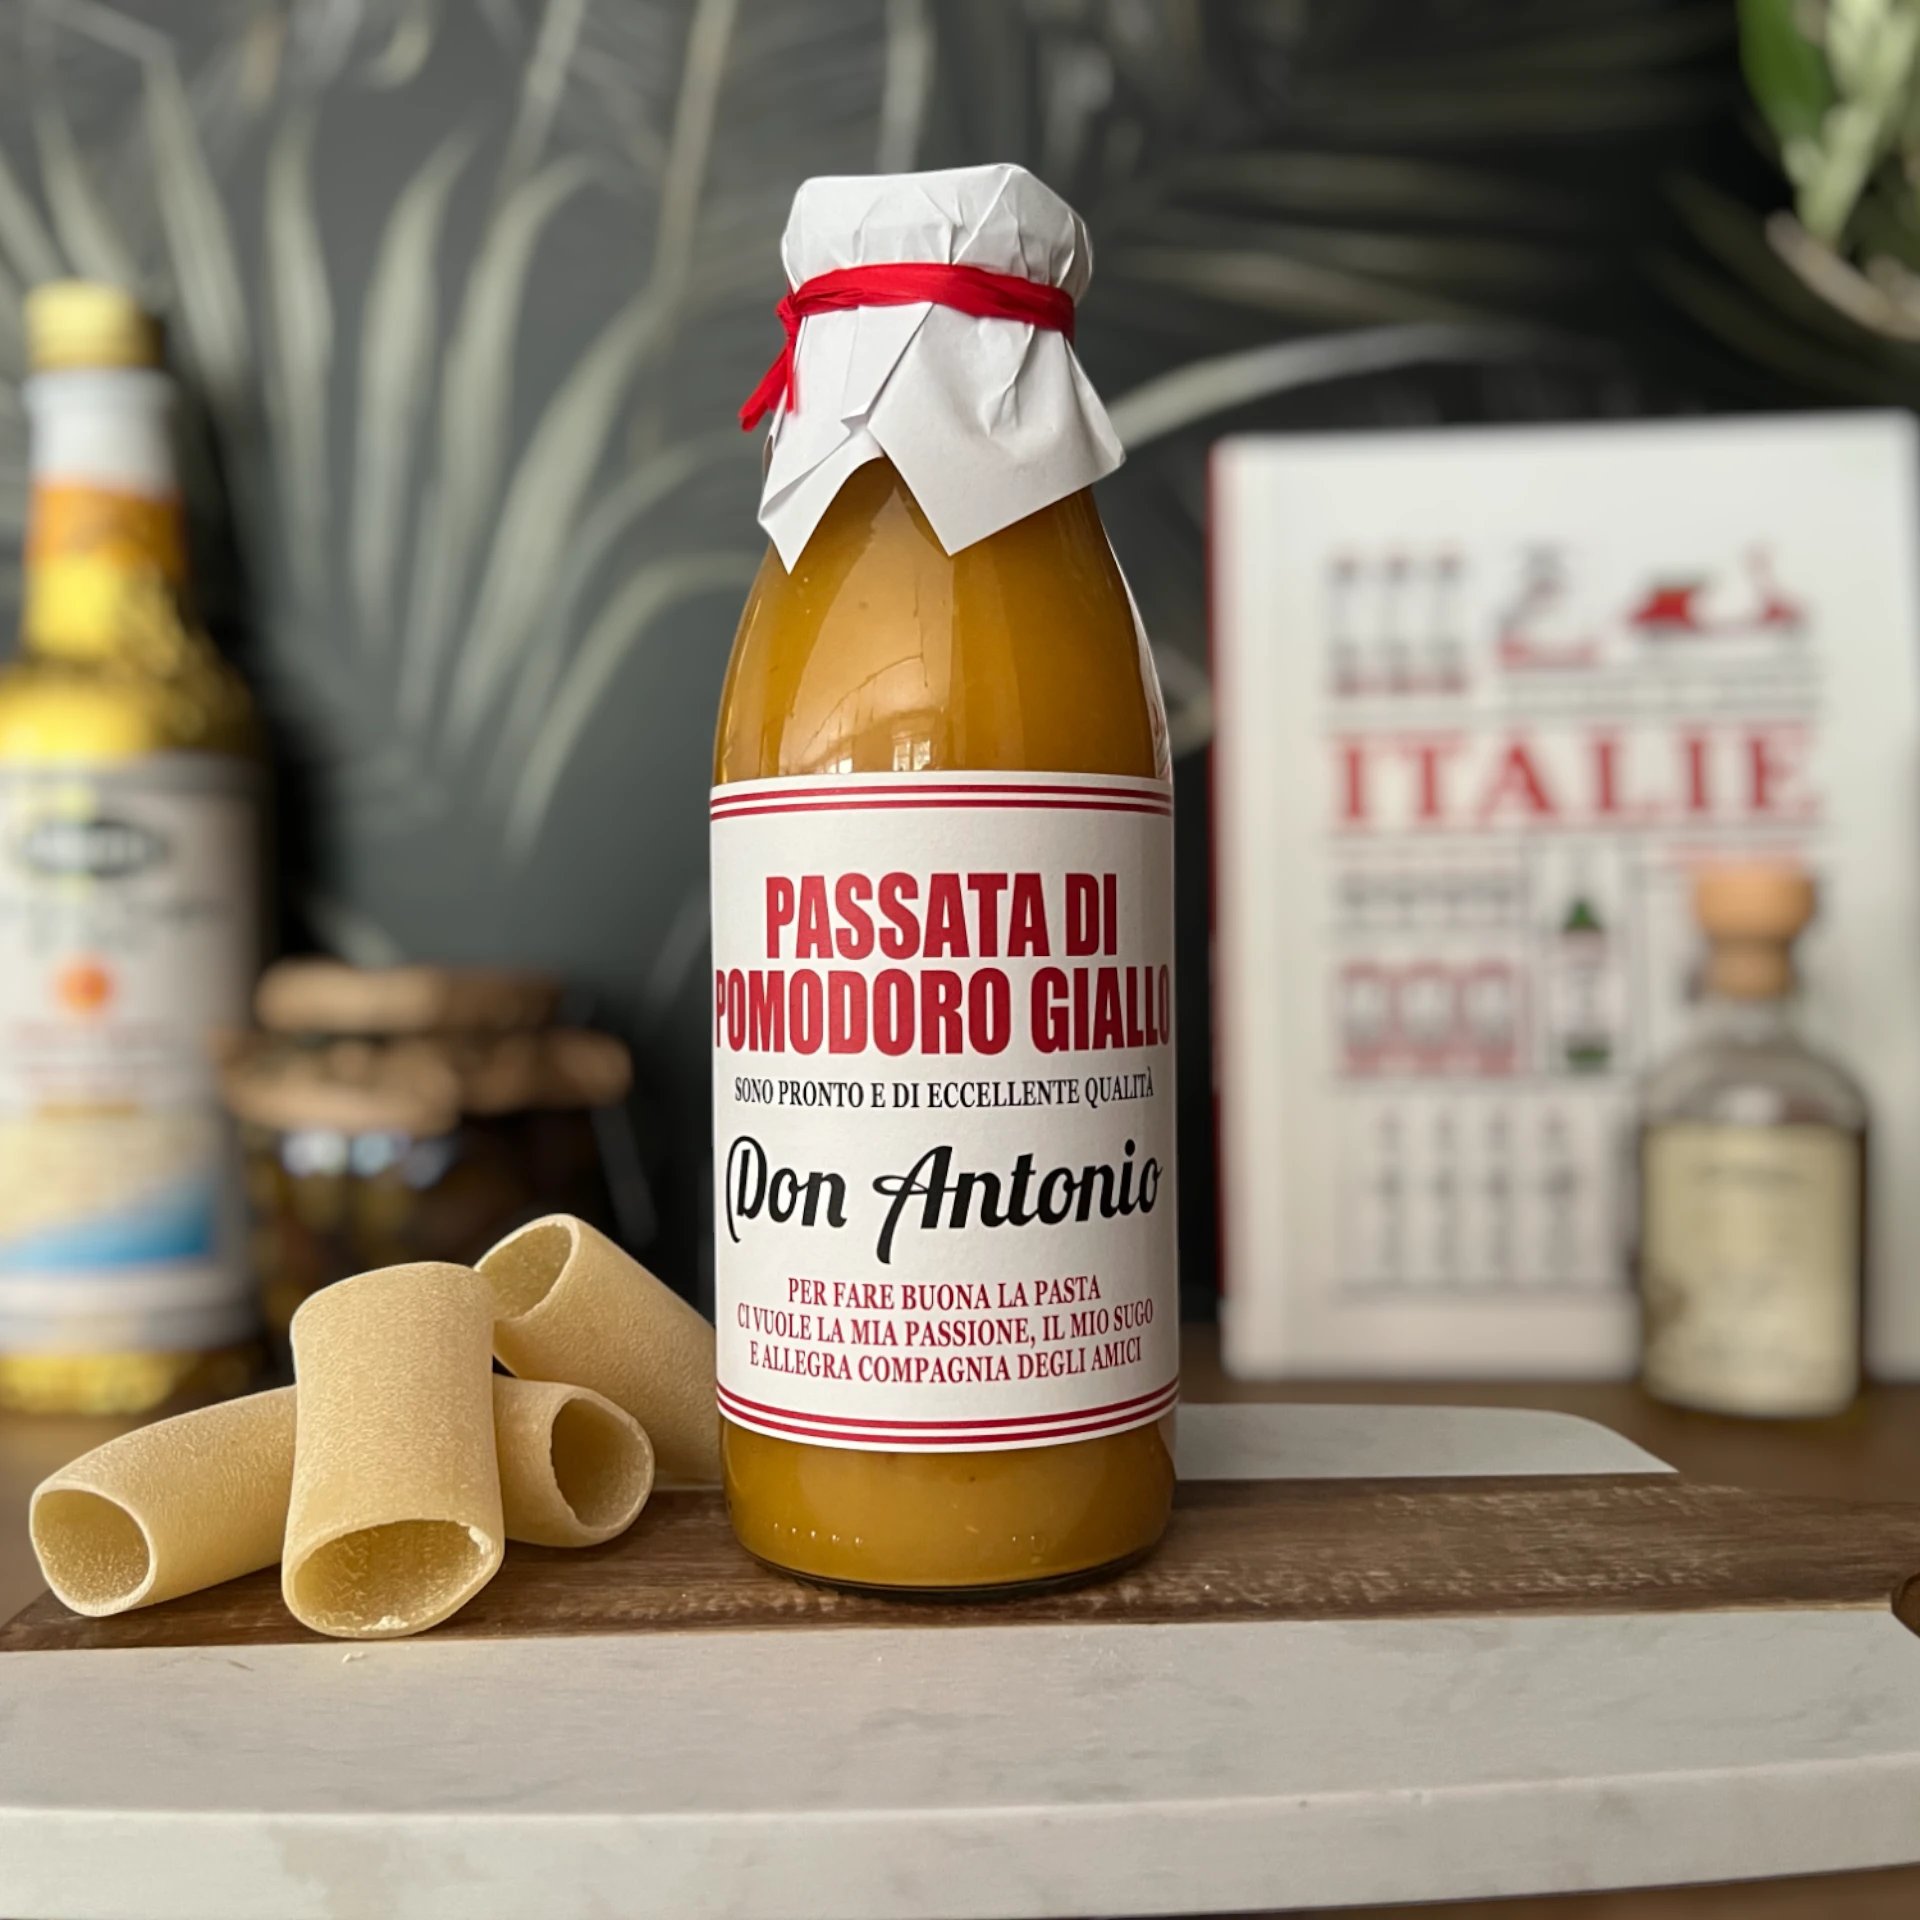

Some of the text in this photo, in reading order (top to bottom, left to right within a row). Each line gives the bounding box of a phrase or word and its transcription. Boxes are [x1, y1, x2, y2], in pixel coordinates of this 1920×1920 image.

[1332, 727, 1820, 828] ITALIE
[766, 872, 1117, 959] PASSATA DI
[716, 964, 1170, 1056] POMODORO GIALLO
[735, 1066, 1154, 1109] SONO PRONTO E DI ECCELLENTE QUALITÀ
[726, 1135, 1163, 1264] Don Antonio
[737, 1298, 1154, 1349] CI VUOLE LA MIA PASSIONE, IL MIO SUGO
[788, 1275, 1101, 1310] PER FARE BUONA LA PASTA
[750, 1336, 1142, 1384] E ALLEGRA COMPAGNIA DEGLI AMICI
